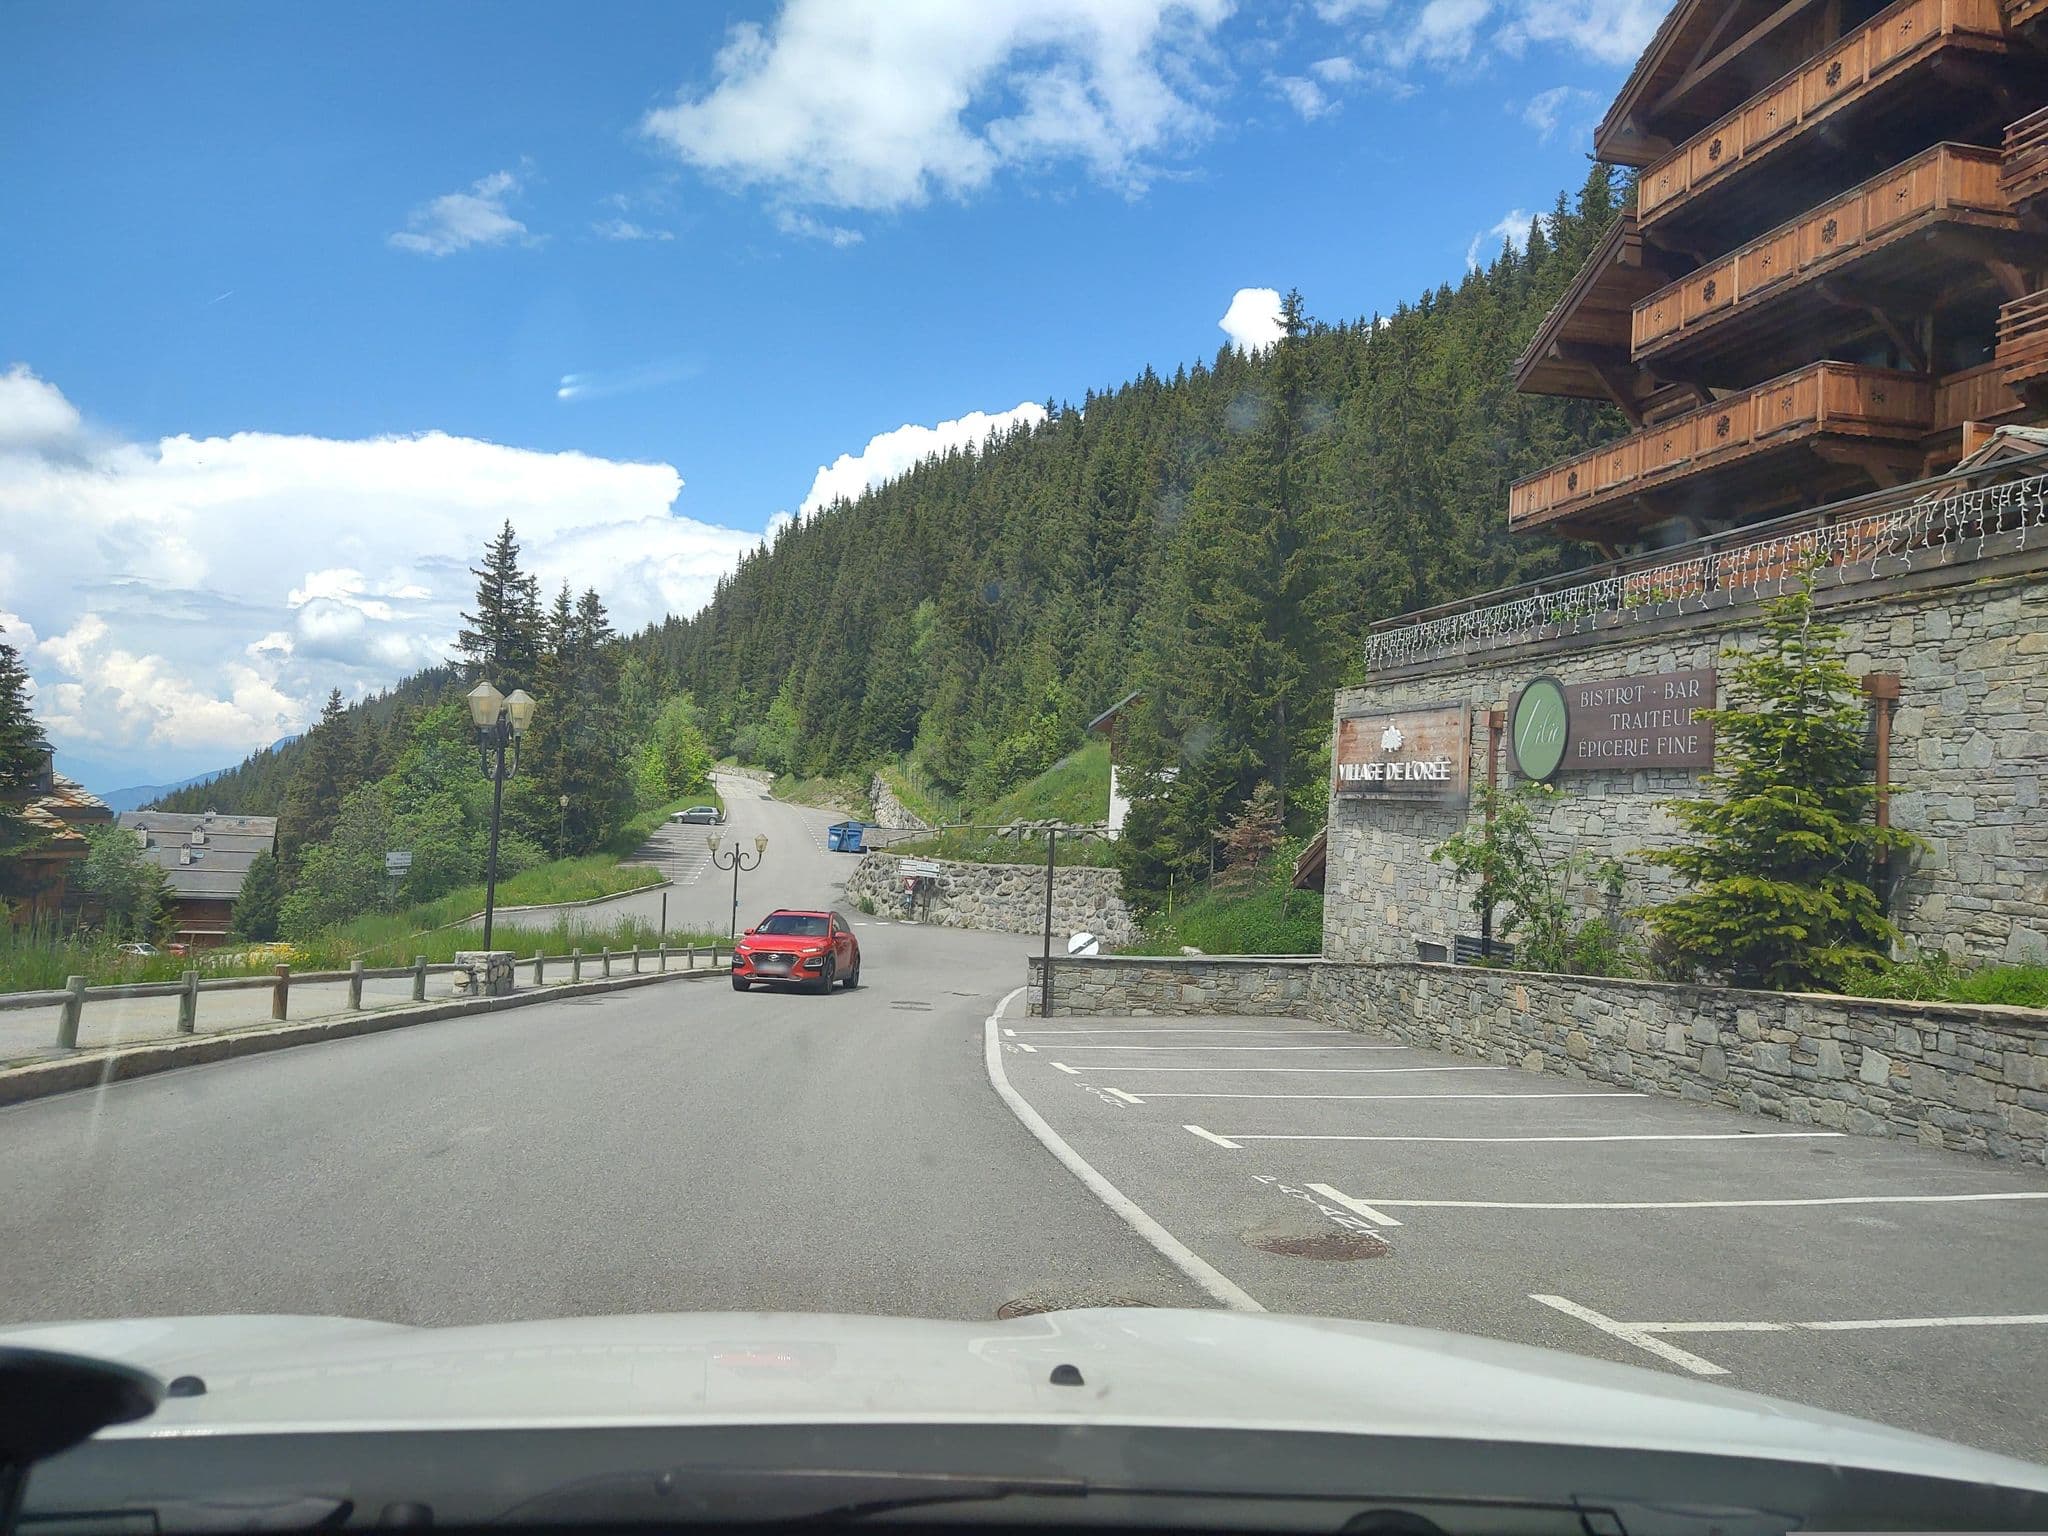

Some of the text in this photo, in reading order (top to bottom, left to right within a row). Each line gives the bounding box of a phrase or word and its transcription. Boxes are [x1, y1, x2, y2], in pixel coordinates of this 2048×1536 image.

[1580, 679, 1699, 708] BISTROT BAR
[1609, 708, 1699, 731] TRAITEUR
[1578, 735, 1698, 758] ÉPICERIE FINE
[1339, 763, 1384, 781] VILLAGE
[1386, 762, 1404, 780] DE
[1251, 1174, 1390, 1243] PAYANT
